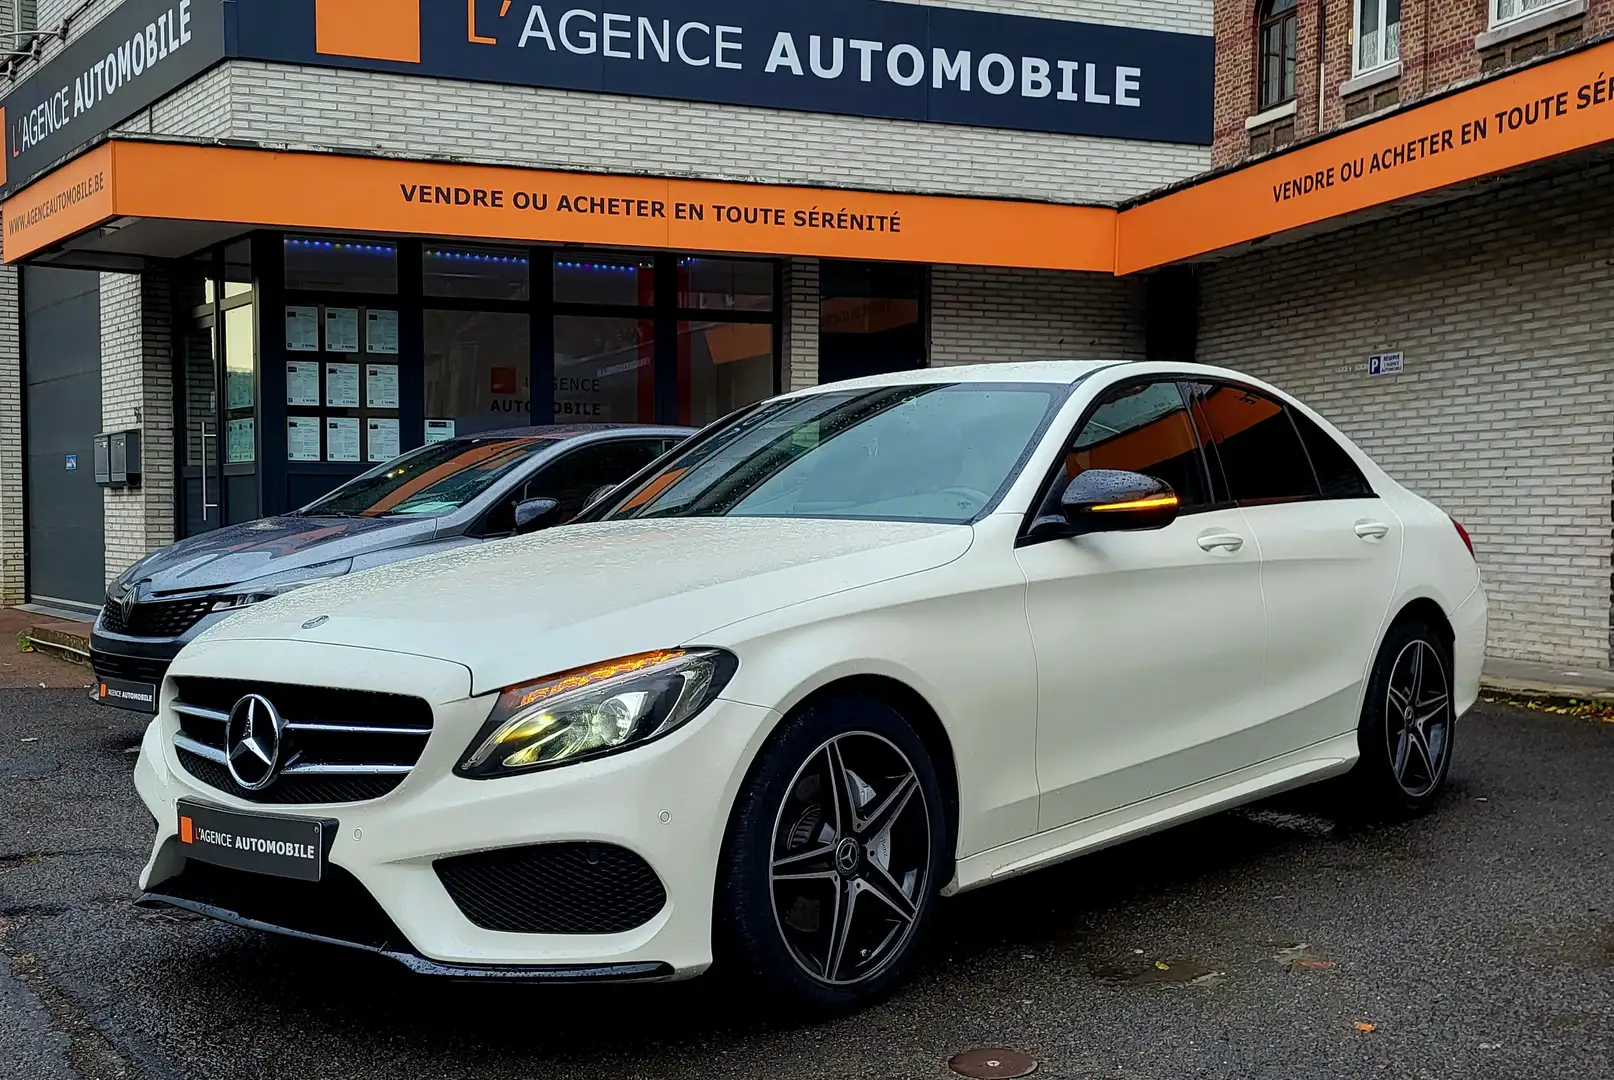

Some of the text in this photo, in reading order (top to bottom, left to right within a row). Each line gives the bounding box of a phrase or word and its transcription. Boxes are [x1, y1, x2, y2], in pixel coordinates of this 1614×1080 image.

[12, 0, 192, 158] L'AGENCE AUTOMOBILE
[468, 0, 1142, 107] L'AGENCE AUTOMOBILE
[1272, 167, 1335, 204] VENDRE
[1340, 157, 1364, 183] OU
[1369, 129, 1454, 175] ACHETER
[1460, 117, 1487, 145] EN
[1495, 91, 1568, 134] TOUTE
[8, 171, 104, 236] WWW.AGENCEAUTOMOBILE.BE
[400, 183, 901, 232] VENDRE OU ACHETER EN TOUTE SÉRÉNITÉ
[490, 398, 601, 416] AUTOOBILE
[122, 691, 153, 702] AUTOMOBILE
[195, 827, 315, 859] L'AGENCE AUTOMOBILE
